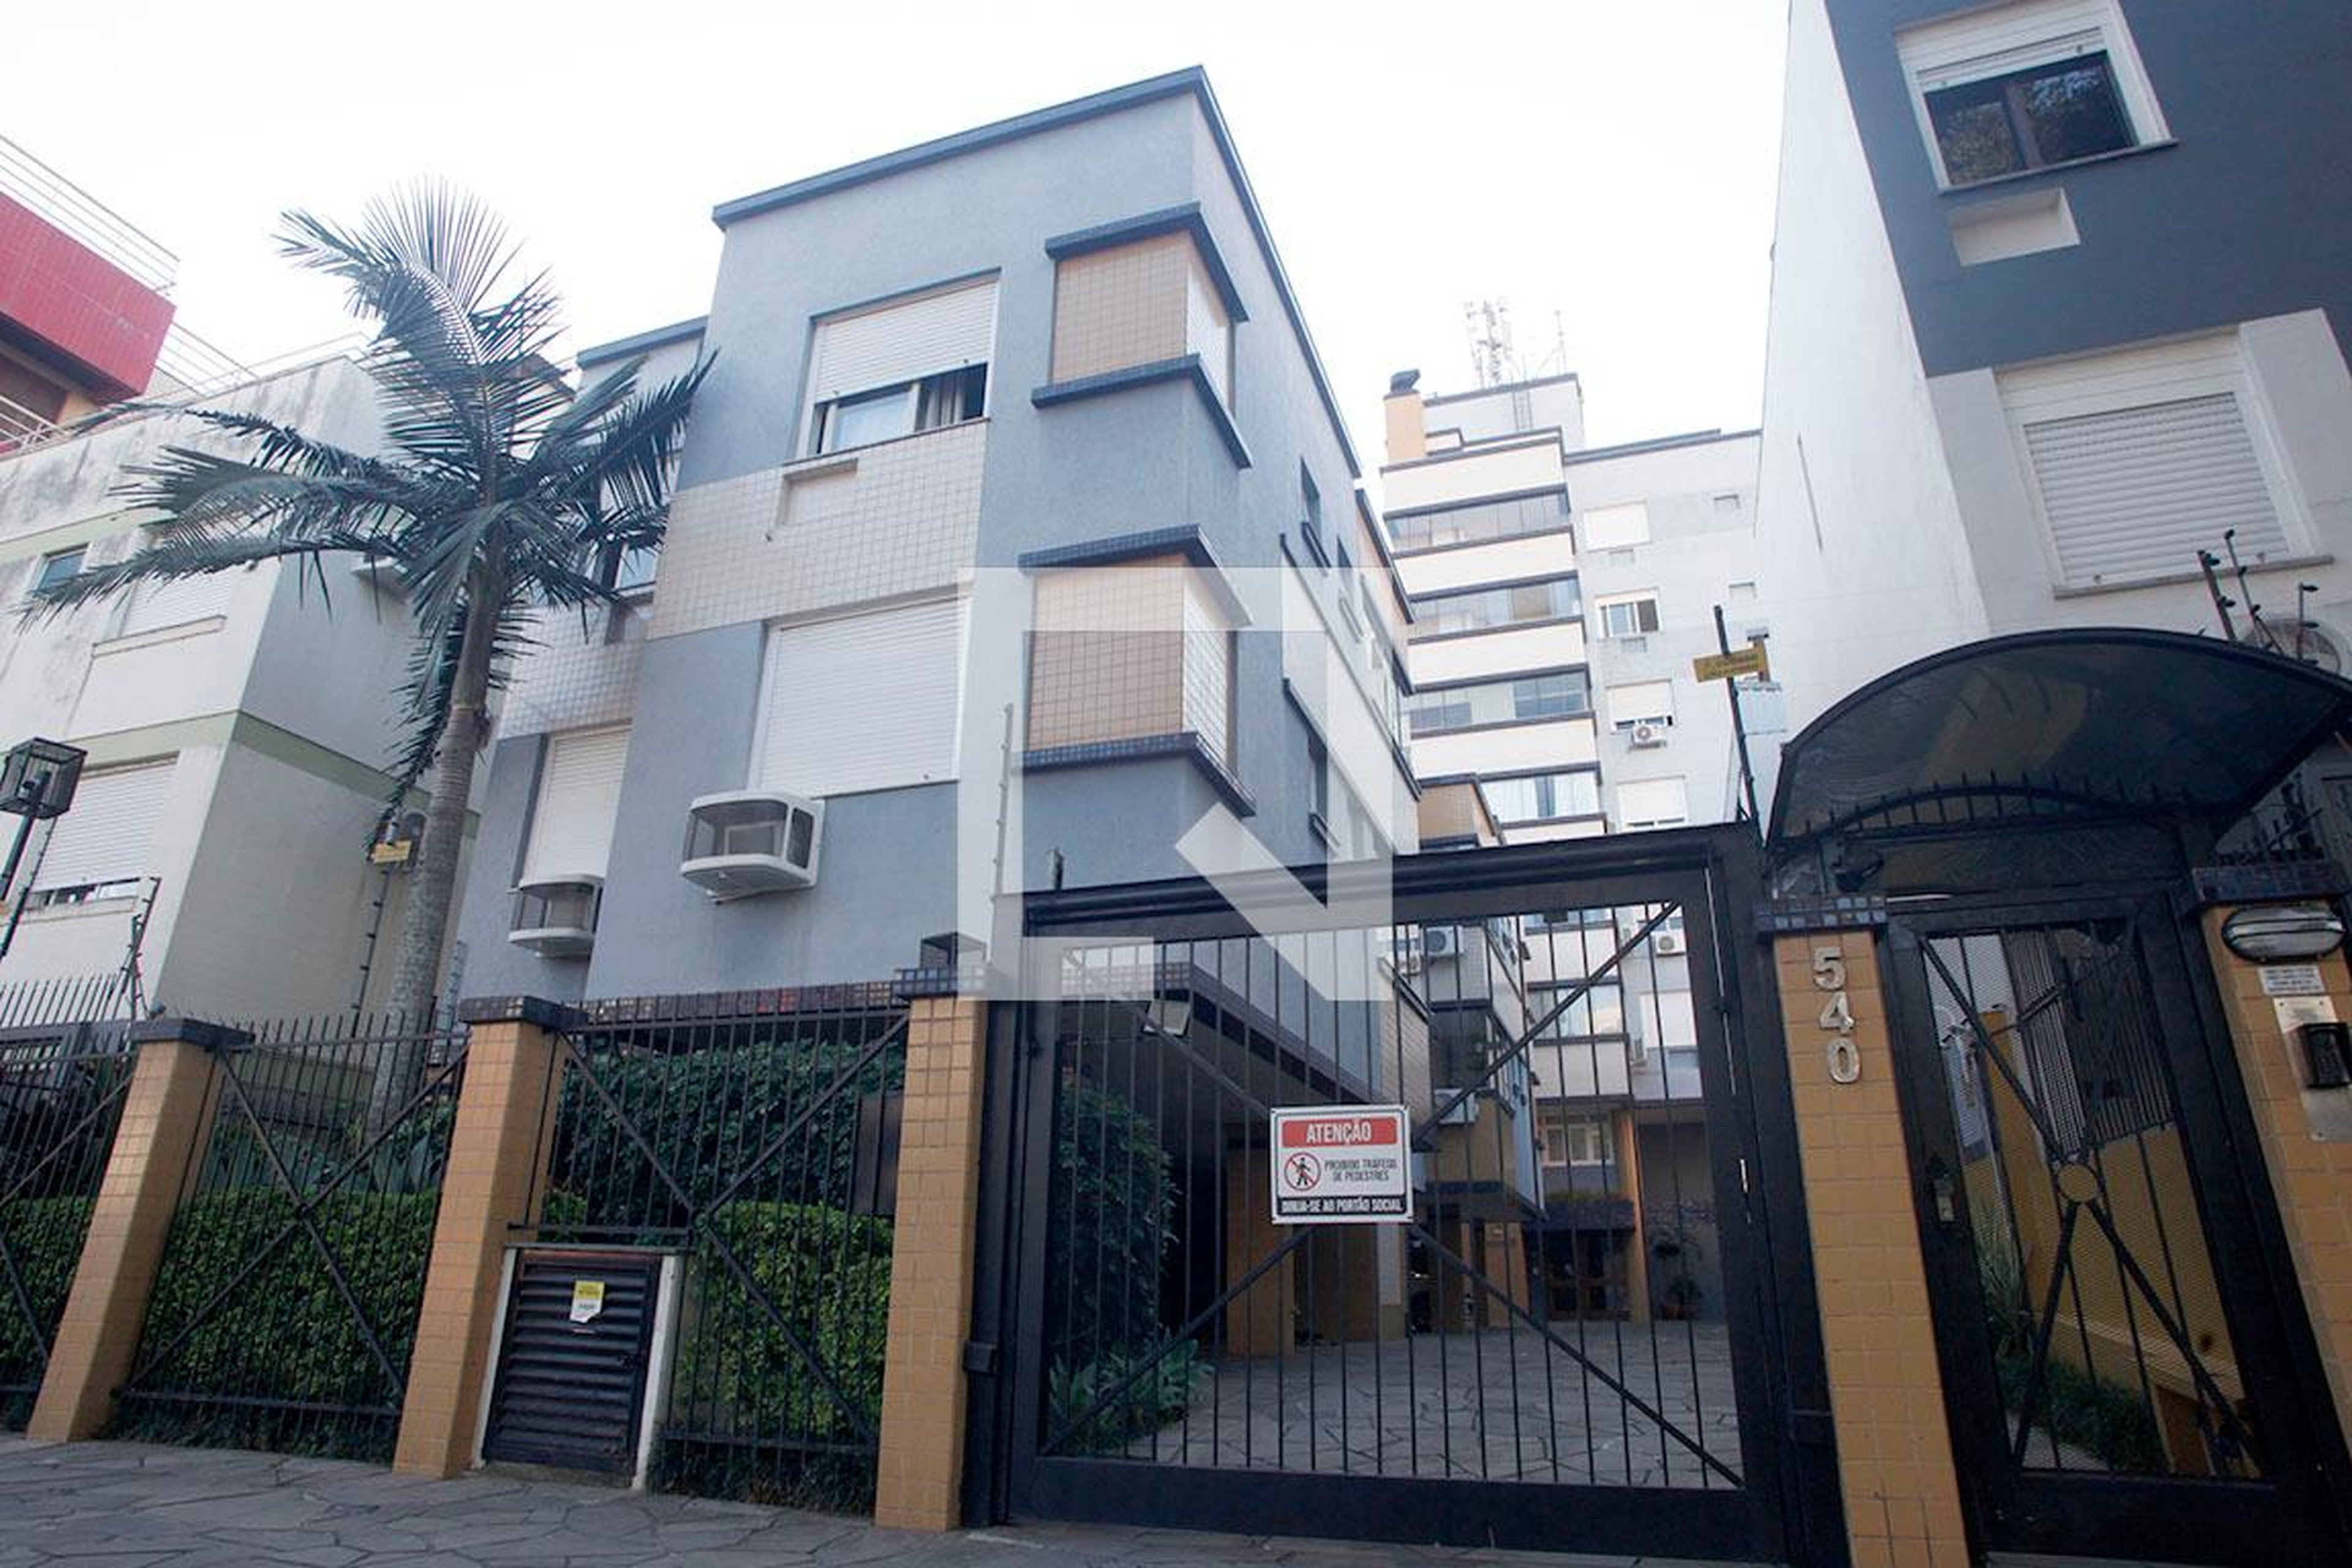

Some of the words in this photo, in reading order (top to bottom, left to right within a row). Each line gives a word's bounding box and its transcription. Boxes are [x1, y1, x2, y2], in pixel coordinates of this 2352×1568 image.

[1813, 947, 1860, 1083] 540
[1344, 1170, 1390, 1182] PEDESTRES
[1372, 1197, 1404, 1212] SOCIAL
